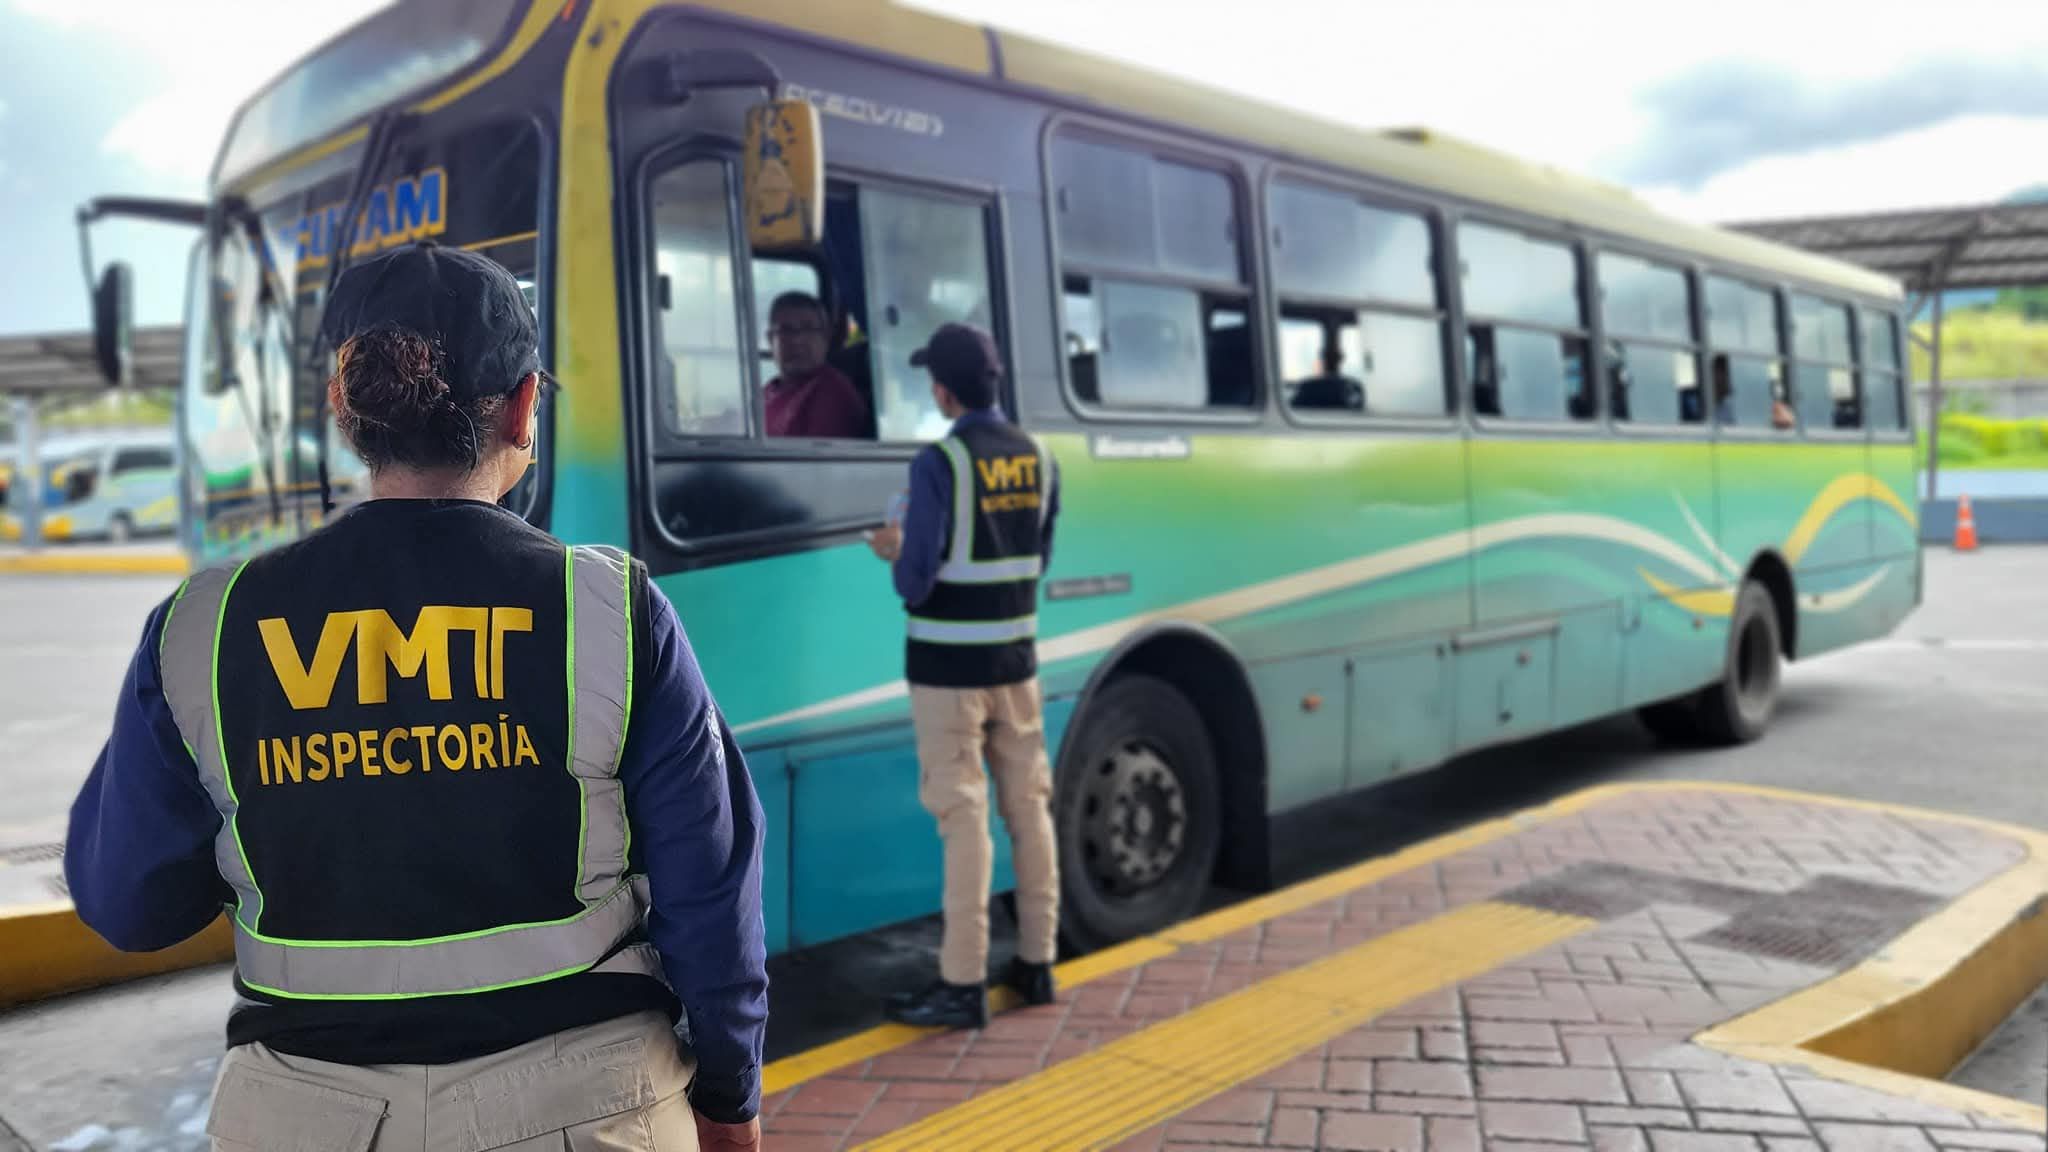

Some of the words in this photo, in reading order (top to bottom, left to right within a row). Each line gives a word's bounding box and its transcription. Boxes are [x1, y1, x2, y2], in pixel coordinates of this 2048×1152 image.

[977, 455, 1037, 490] VMT
[258, 606, 533, 710] VMT
[258, 714, 540, 785] INSPECTORÍA
